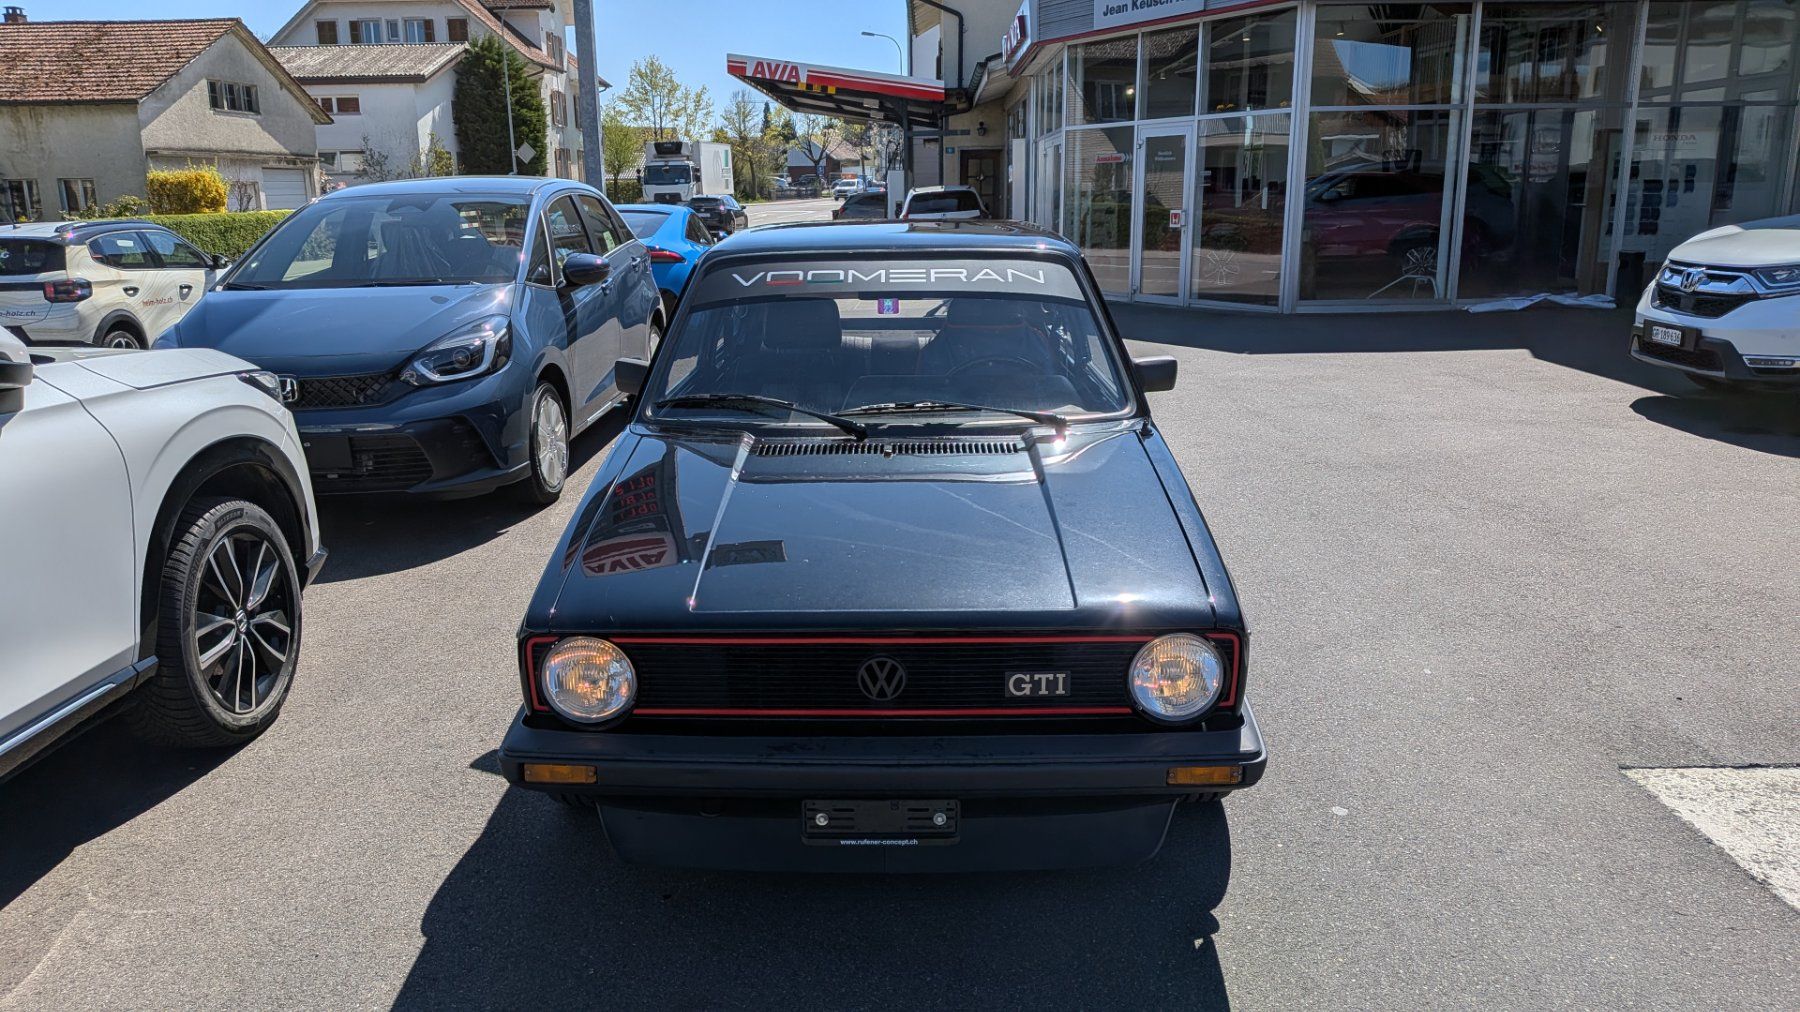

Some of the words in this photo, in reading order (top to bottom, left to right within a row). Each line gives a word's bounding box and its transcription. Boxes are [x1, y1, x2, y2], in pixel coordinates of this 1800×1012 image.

[1102, 3, 1128, 17] Jean
[732, 268, 1045, 287] VOOMERAN
[1008, 673, 1067, 696] GTI
